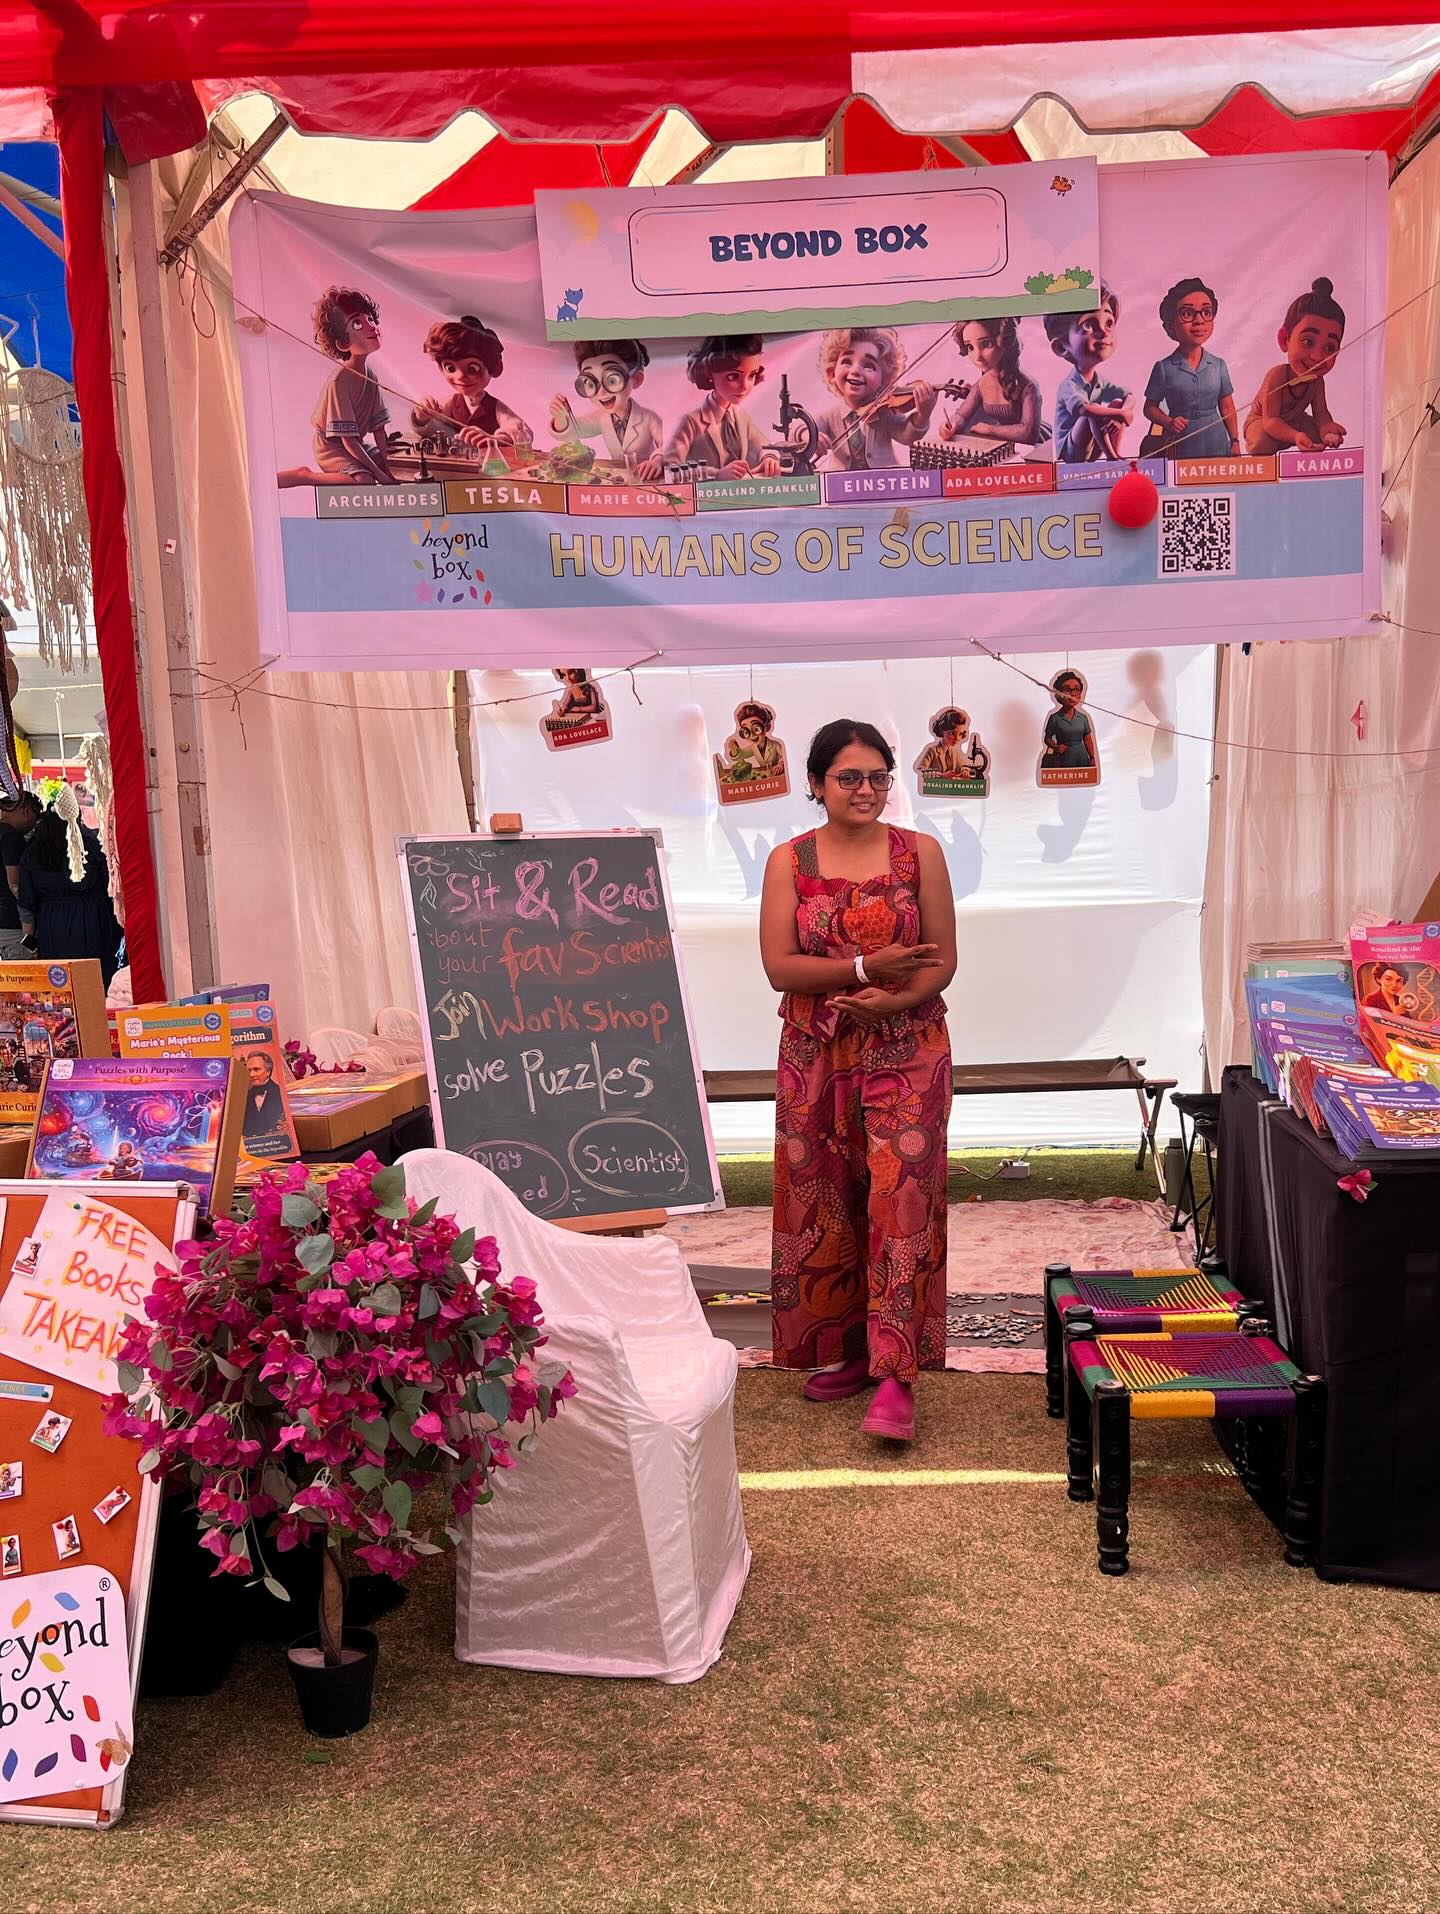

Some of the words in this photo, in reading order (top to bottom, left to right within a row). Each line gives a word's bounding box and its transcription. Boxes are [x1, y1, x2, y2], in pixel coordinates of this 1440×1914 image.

[709, 229, 842, 263] BEYOND
[854, 223, 929, 254] BOX
[1179, 463, 1265, 478] KATHERINE
[1296, 457, 1355, 473] KANAD
[946, 477, 973, 489] ADA
[977, 473, 1044, 487] LOVELACE
[1104, 468, 1155, 480] SARAHAI
[698, 486, 756, 499] ROSALIND
[760, 482, 818, 495] FRANKLIN
[844, 475, 931, 493] EINSTEIN
[328, 493, 440, 508] ARCHIMEDES
[465, 486, 543, 506] TESLA
[580, 493, 630, 506] MARIE
[421, 524, 489, 559] beyond
[549, 530, 782, 578] HUMANS
[795, 526, 864, 574] OF
[878, 512, 1103, 569] SCIENCE
[431, 553, 473, 581] box
[553, 733, 568, 742] ADA
[569, 726, 602, 739] LOVELACE
[1042, 771, 1089, 780] KATHERINE
[727, 785, 754, 795] MARIE
[755, 781, 780, 791] CURIE
[446, 871, 501, 913] Sit
[515, 860, 560, 928] &
[567, 857, 662, 926] Read
[437, 955, 494, 985] your
[498, 927, 565, 993] fav
[5, 974, 34, 984] Purpose
[130, 1036, 166, 1049] Marie's
[167, 1033, 221, 1047] Mysterious
[94, 1065, 127, 1075] Puzzles
[128, 1064, 149, 1075] with
[150, 1065, 186, 1077] Purpose
[444, 1058, 511, 1100] solve
[582, 1143, 688, 1175] Scientist
[75, 1207, 148, 1261] FREE
[61, 1250, 145, 1306] Books
